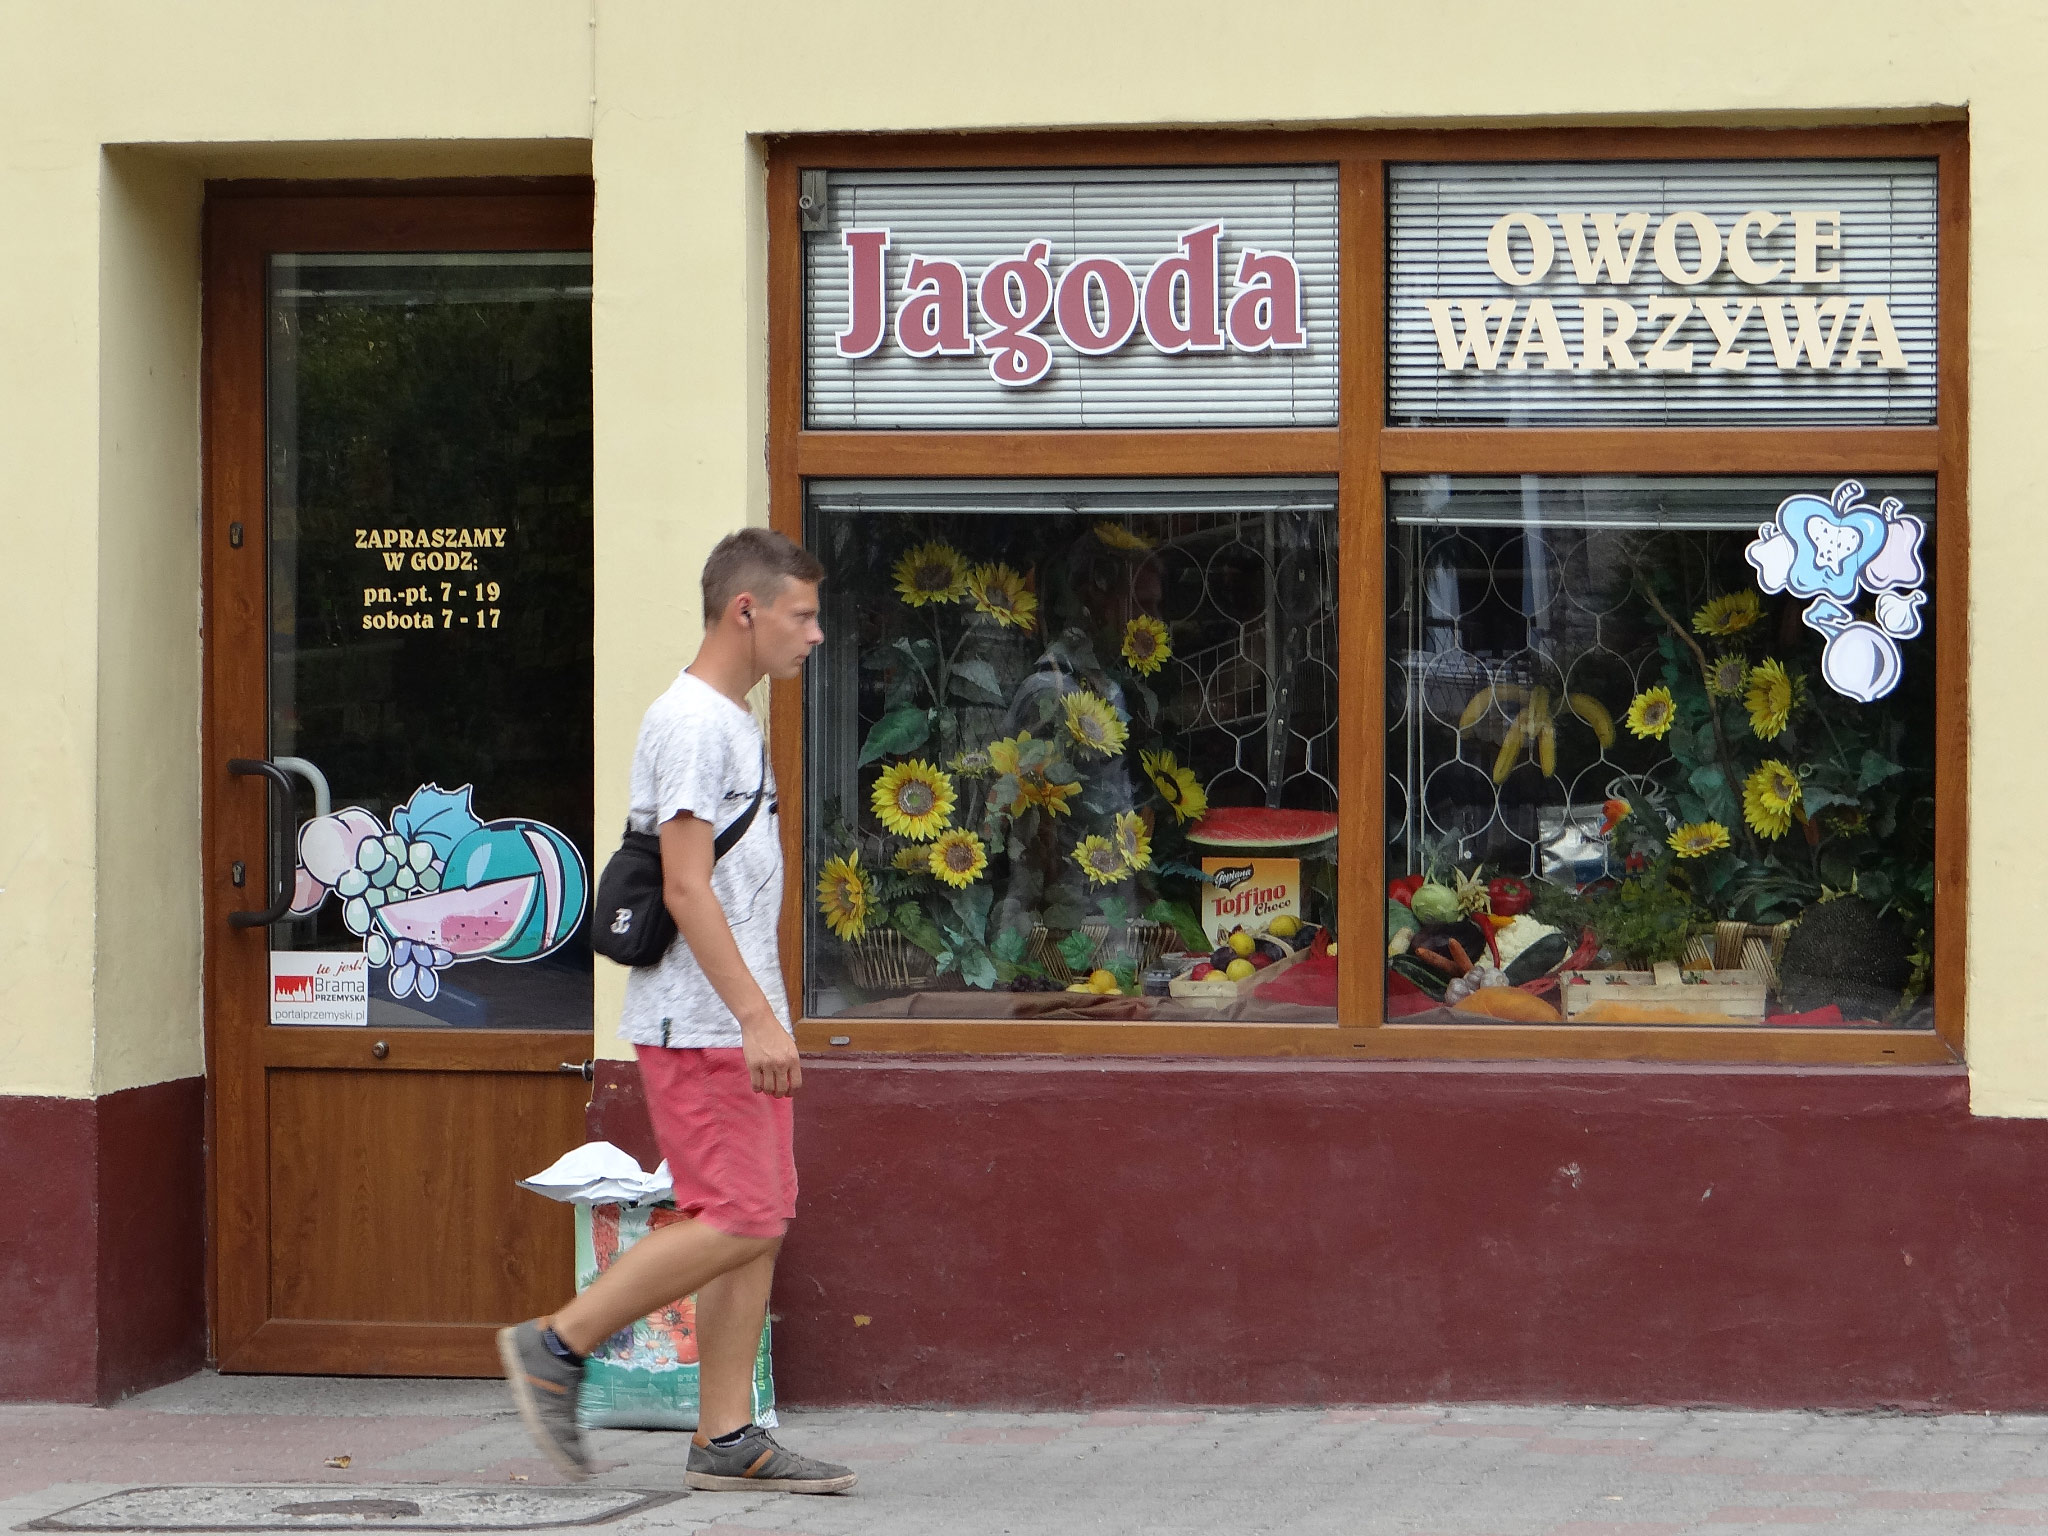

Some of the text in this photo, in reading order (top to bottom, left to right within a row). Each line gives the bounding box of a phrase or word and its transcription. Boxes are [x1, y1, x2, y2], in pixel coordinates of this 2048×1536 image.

[1486, 210, 1841, 286] OWOCE
[836, 218, 1307, 387] Jagoda
[1425, 295, 1909, 374] WARZYWA
[354, 527, 507, 549] ZAPRASZAMY
[382, 551, 479, 572] W GODZ:
[363, 584, 433, 607] pn.-pt.
[440, 581, 452, 602] 7
[475, 581, 501, 602] 19
[362, 609, 434, 630] sobota
[441, 608, 453, 629] 7
[476, 608, 501, 629] 17
[1211, 885, 1287, 918] Toffino
[1254, 899, 1292, 917] Choco
[315, 977, 365, 993] Brama
[315, 994, 366, 1003] PRZEMYSKA
[275, 1009, 365, 1021] portalprzemyski.pl
